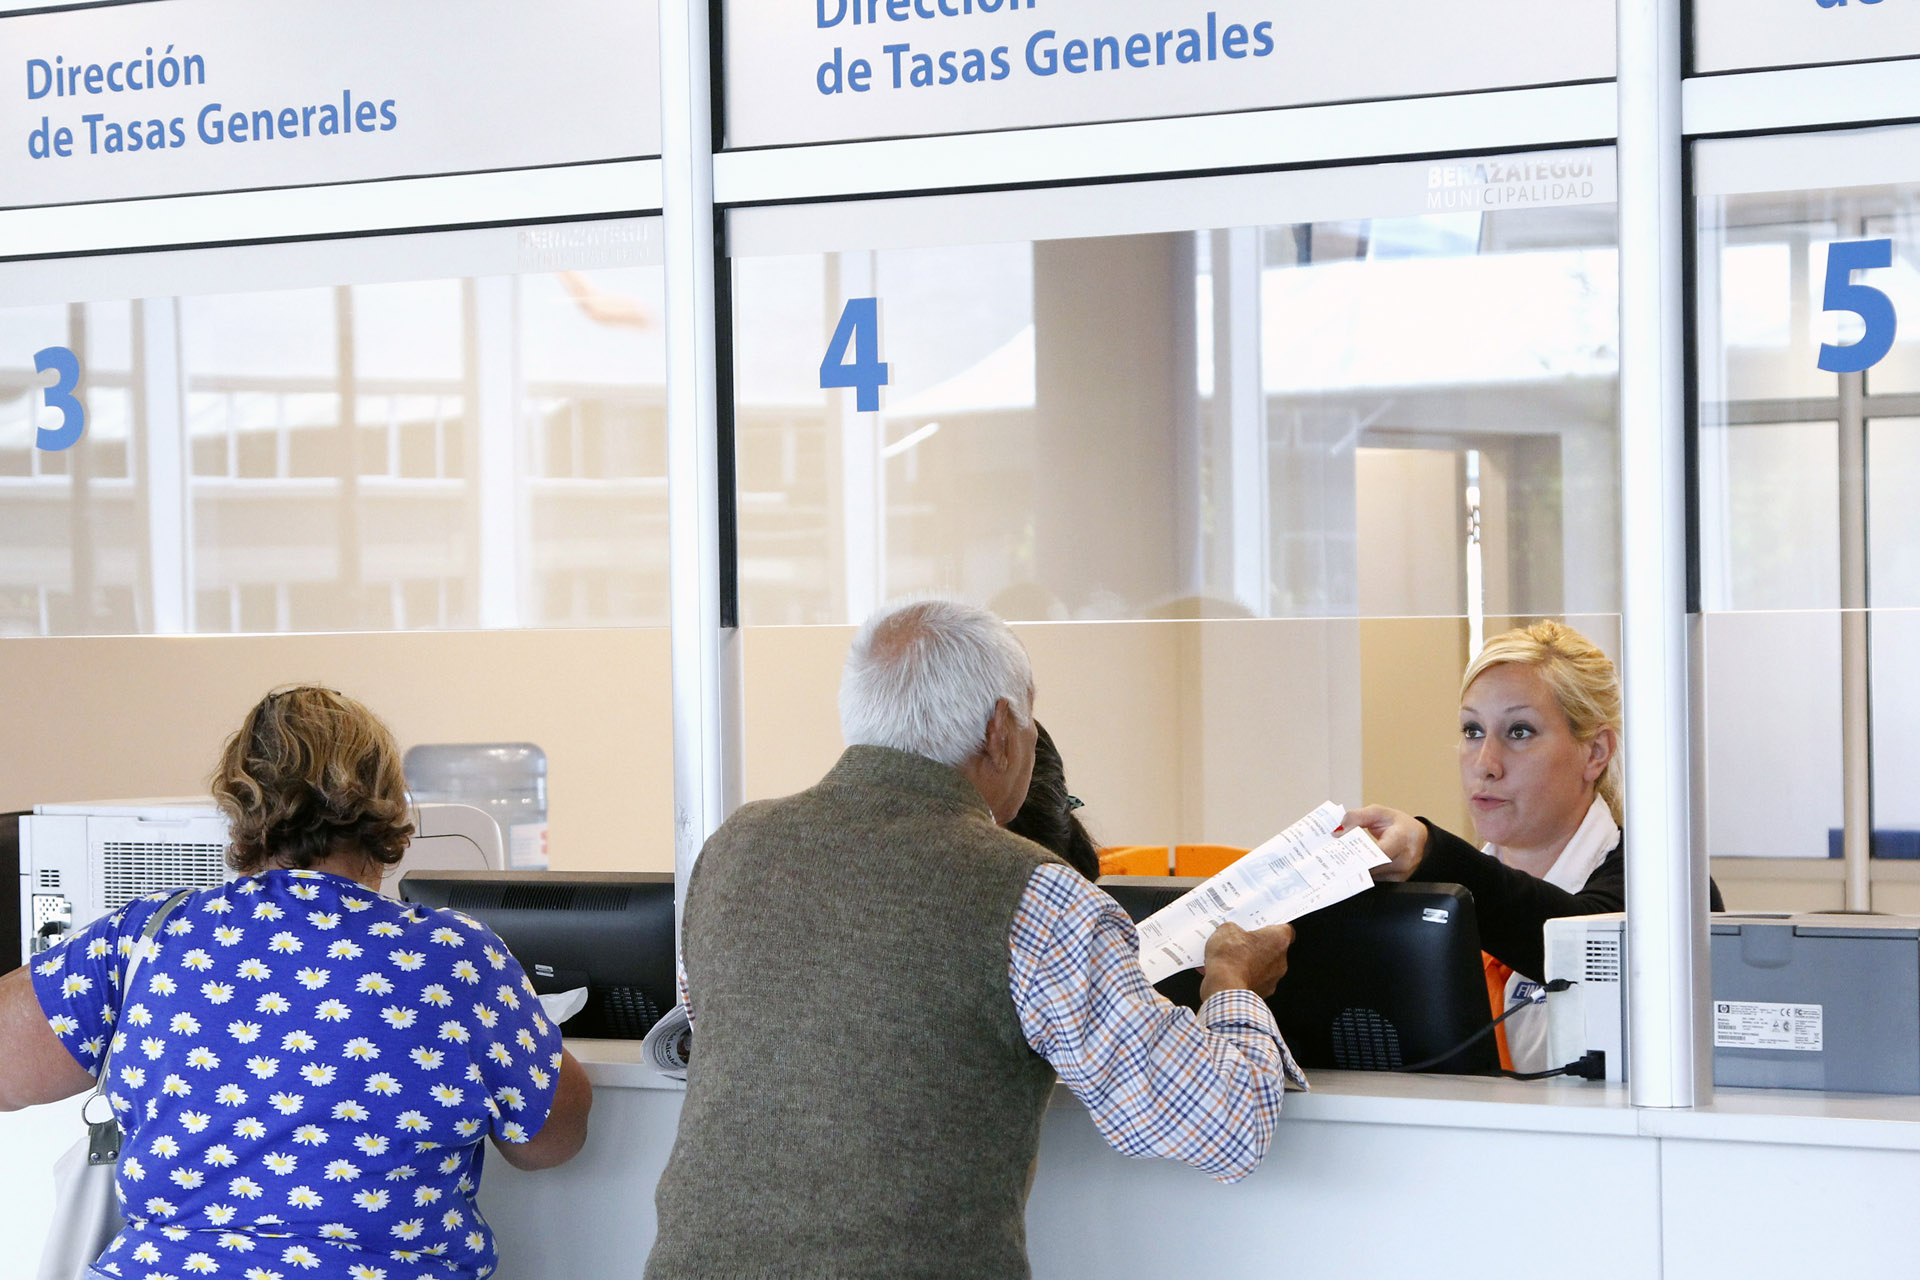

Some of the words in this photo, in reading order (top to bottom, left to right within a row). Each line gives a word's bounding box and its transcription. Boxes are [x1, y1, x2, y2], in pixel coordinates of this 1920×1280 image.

[817, 0, 1037, 29] Direcc
[27, 45, 206, 100] Dirección
[817, 47, 873, 96] de
[882, 42, 1011, 90] Tasas
[1025, 11, 1275, 77] Generales
[28, 116, 74, 159] de
[81, 112, 187, 156] Tasas
[197, 89, 398, 145] Generales
[1427, 157, 1594, 189] BERAZATEGUI
[1427, 181, 1595, 210] MUNICIPALIDAD
[1817, 238, 1897, 374] 5
[820, 297, 889, 412] 4
[34, 346, 85, 452] 3
